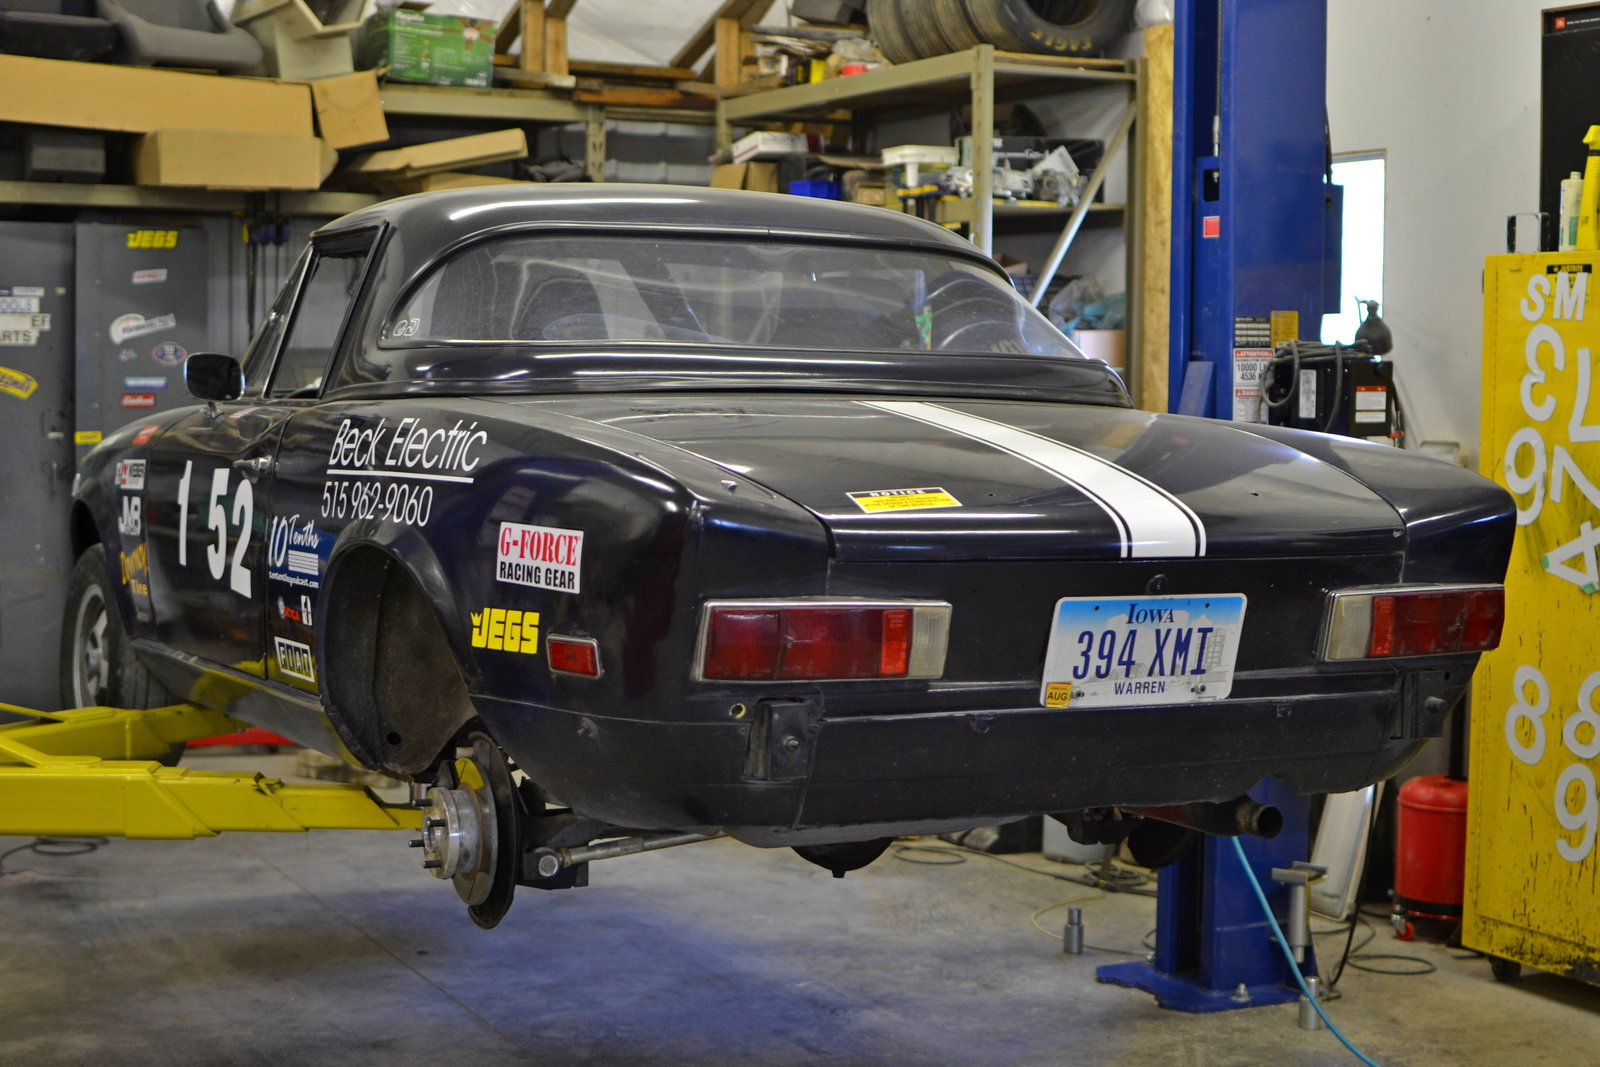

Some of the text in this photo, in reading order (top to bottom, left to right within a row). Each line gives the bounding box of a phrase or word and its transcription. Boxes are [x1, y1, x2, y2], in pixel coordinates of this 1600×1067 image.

[127, 230, 178, 249] JEGS
[1520, 272, 1588, 322] SM
[0, 330, 32, 342] RTS
[328, 418, 487, 471] Beck Electric
[322, 481, 433, 527] 515 962-9060
[500, 527, 579, 567] G-FORCE
[500, 561, 575, 590] RACING GEAR
[471, 607, 540, 655] JEGS
[279, 646, 309, 672] FIAT
[1072, 627, 1214, 680] 394 XMI
[1047, 691, 1069, 701] AUG
[1114, 681, 1166, 695] WARREN
